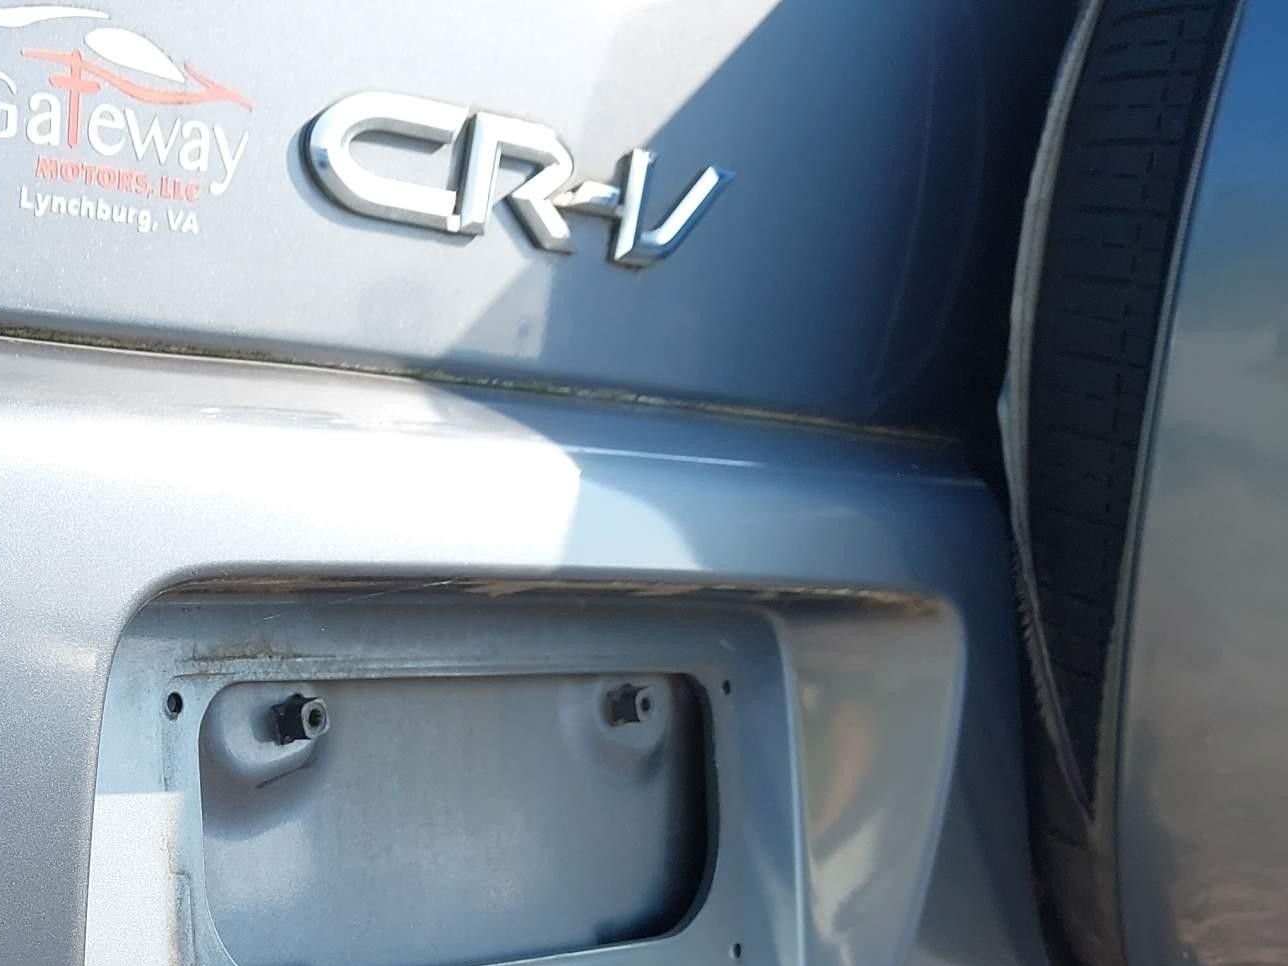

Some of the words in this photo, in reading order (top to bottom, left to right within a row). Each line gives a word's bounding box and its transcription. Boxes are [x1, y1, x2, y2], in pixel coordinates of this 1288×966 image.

[35, 154, 153, 198] MOTORS,
[159, 174, 200, 203] LLC
[298, 90, 736, 272] CR-V
[19, 184, 159, 234] Lynchburg,
[167, 208, 199, 235] VA
